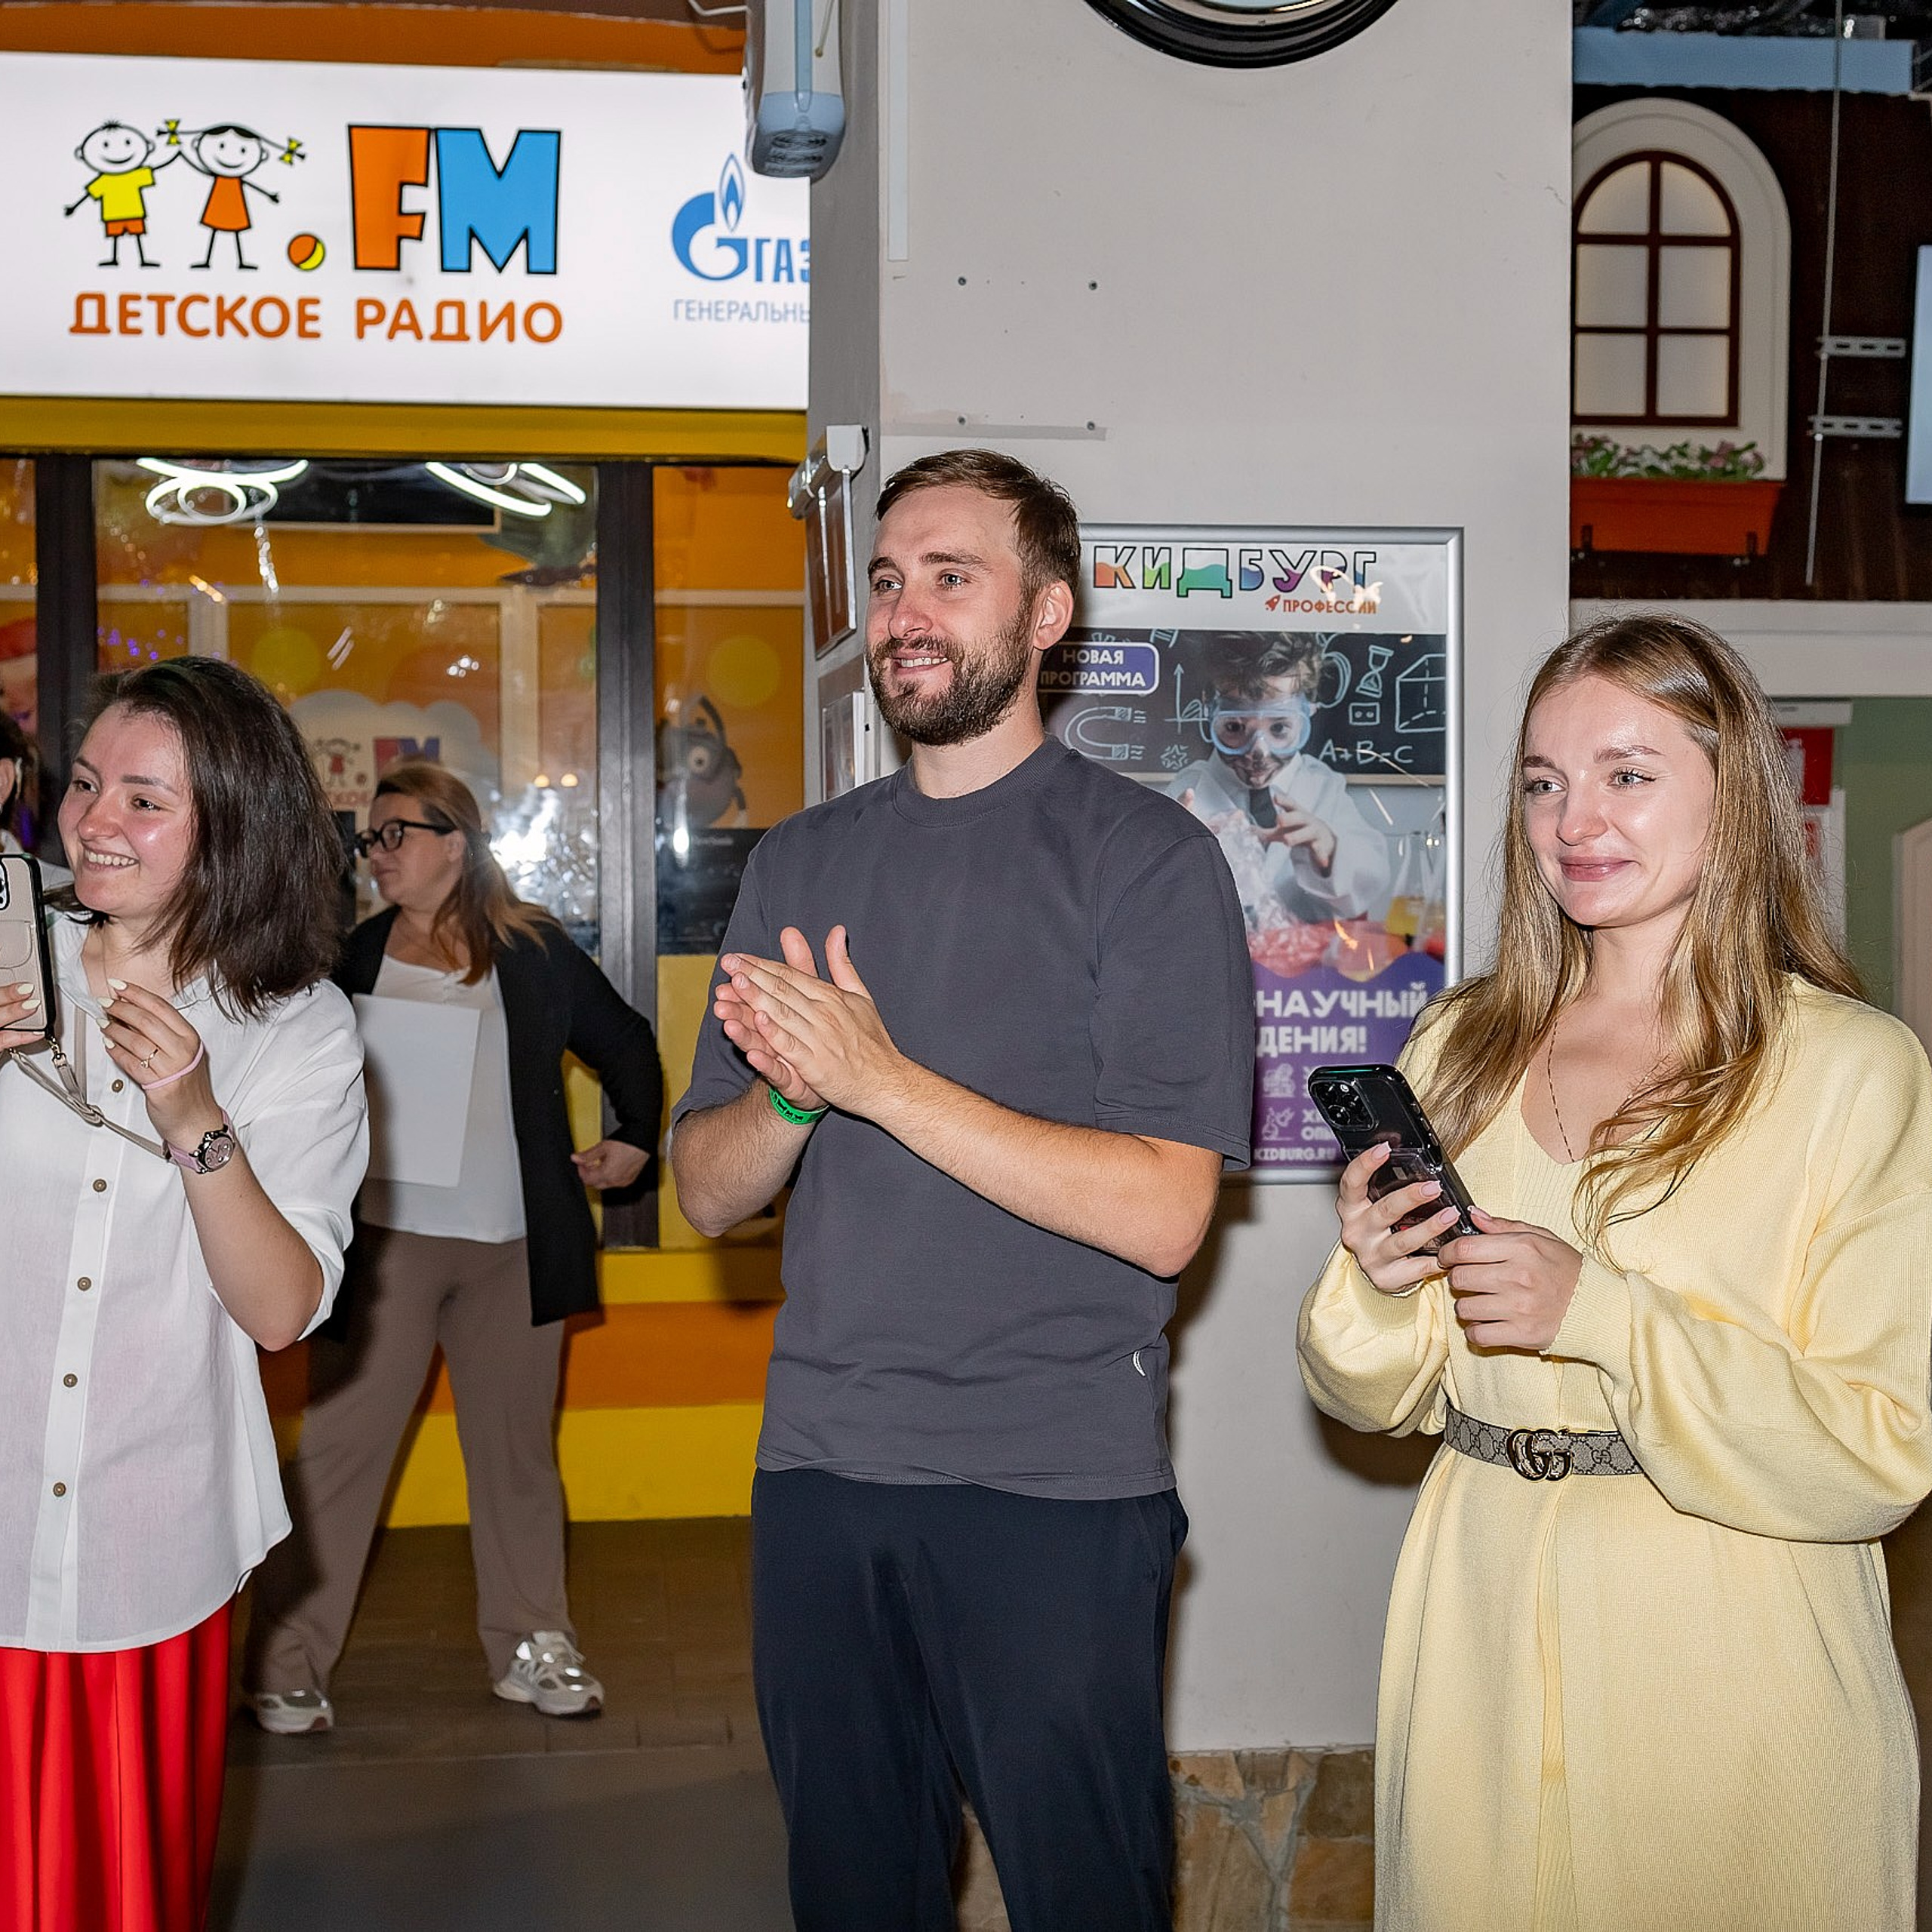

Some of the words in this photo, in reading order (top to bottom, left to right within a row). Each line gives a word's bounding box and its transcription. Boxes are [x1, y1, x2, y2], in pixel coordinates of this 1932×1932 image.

[348, 125, 561, 275] FM
[69, 293, 321, 339] ДЕТСКОЕ
[355, 298, 563, 343] РАДИО
[1093, 545, 1377, 598] КИДБУРГ
[1040, 670, 1146, 687] ПРОГРАММА
[1063, 649, 1124, 665] НОВАЯ
